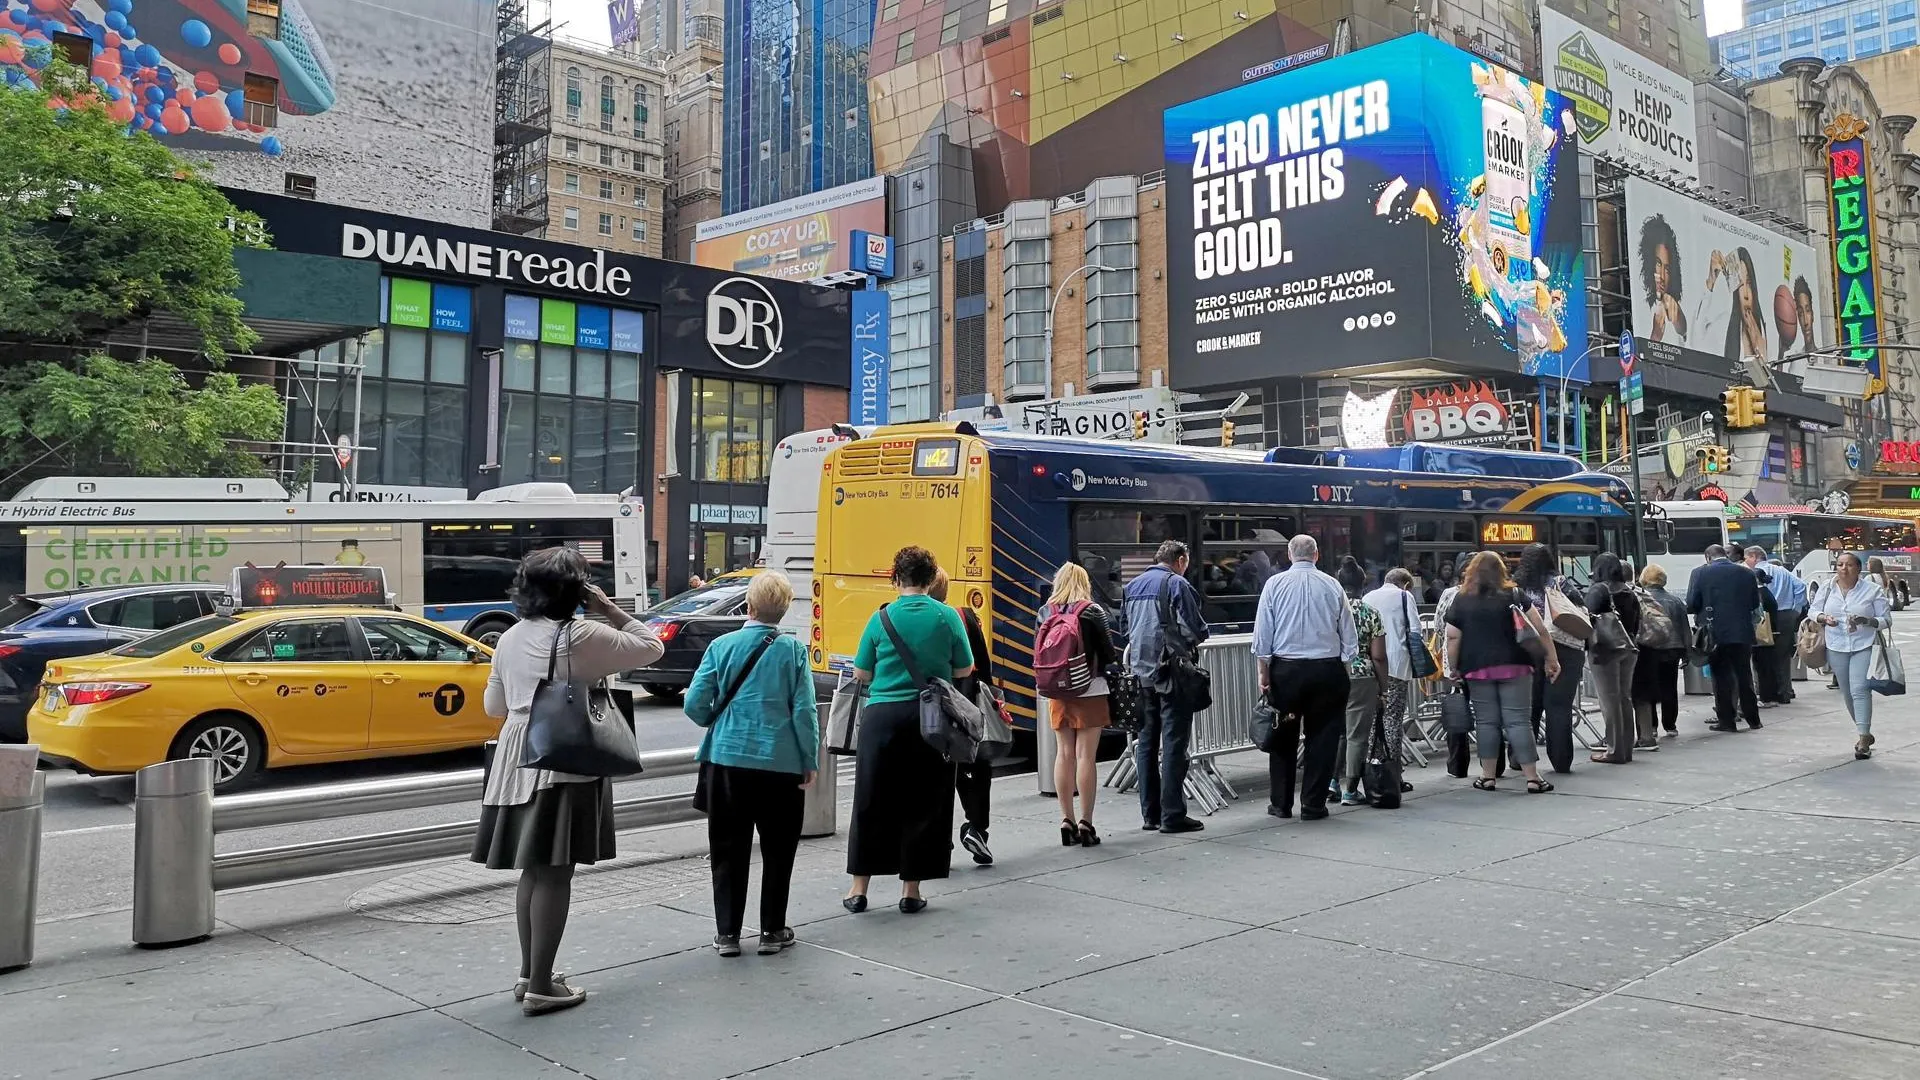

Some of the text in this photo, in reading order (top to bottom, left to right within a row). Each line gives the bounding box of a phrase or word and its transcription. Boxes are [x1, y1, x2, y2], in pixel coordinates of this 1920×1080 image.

[1244, 47, 1325, 79] OUTFRONT PRIME
[1555, 69, 1584, 94] UNCLE
[1587, 82, 1611, 110] BUD'S
[1613, 59, 1637, 79] UNCLE
[1638, 71, 1658, 90] BUD'S
[1659, 82, 1688, 105] NATURAL
[1634, 88, 1672, 126] HEMP
[1192, 79, 1390, 179] ZERO NEVER
[1619, 108, 1693, 163] PRODUCTS
[1486, 128, 1525, 170] CROOK
[1624, 147, 1648, 164] trusted
[1193, 147, 1345, 230] FELT THIS
[735, 217, 753, 228] product
[746, 220, 824, 252] COZY UP.
[1194, 217, 1293, 280] GOOD.
[1830, 149, 1875, 361] REGAL
[342, 223, 632, 296] DUANE reade
[1195, 268, 1374, 311] ZERO SUGAR BOLD FLAVOR
[395, 304, 420, 313] WHAT
[1196, 279, 1396, 324] MADE WITH ORGANIC ALCOHOL
[436, 308, 456, 317] HOW
[441, 318, 464, 328] FEEL
[508, 319, 526, 327] HOW
[544, 323, 566, 332] WHAT
[580, 327, 597, 335] HOW
[707, 294, 783, 353] DR
[855, 311, 880, 340] Rx
[584, 336, 604, 345] FEEL
[614, 332, 632, 340] HOW
[1427, 394, 1480, 407] DALLAS
[1412, 402, 1504, 440] BBQ
[1480, 434, 1507, 443] STEAKS
[925, 448, 949, 467] M42
[931, 483, 959, 498] 7614
[1087, 475, 1103, 484] New
[1104, 476, 1120, 485] York
[1120, 477, 1134, 487] City
[1135, 477, 1148, 487] Bus
[845, 491, 855, 499] New
[867, 490, 878, 499] City
[1312, 484, 1353, 502] I NY
[12, 506, 57, 518] Hybrid
[60, 506, 108, 516] Electric
[112, 506, 136, 516] Bus
[702, 505, 757, 522] pharmacy
[1484, 522, 1533, 541] M42 CROSSTOWN
[45, 537, 229, 560] CERTIFIED
[44, 564, 211, 590] ORGANIC
[292, 580, 379, 595] MOULIN ROUGE!
[419, 690, 458, 712] NYC T
